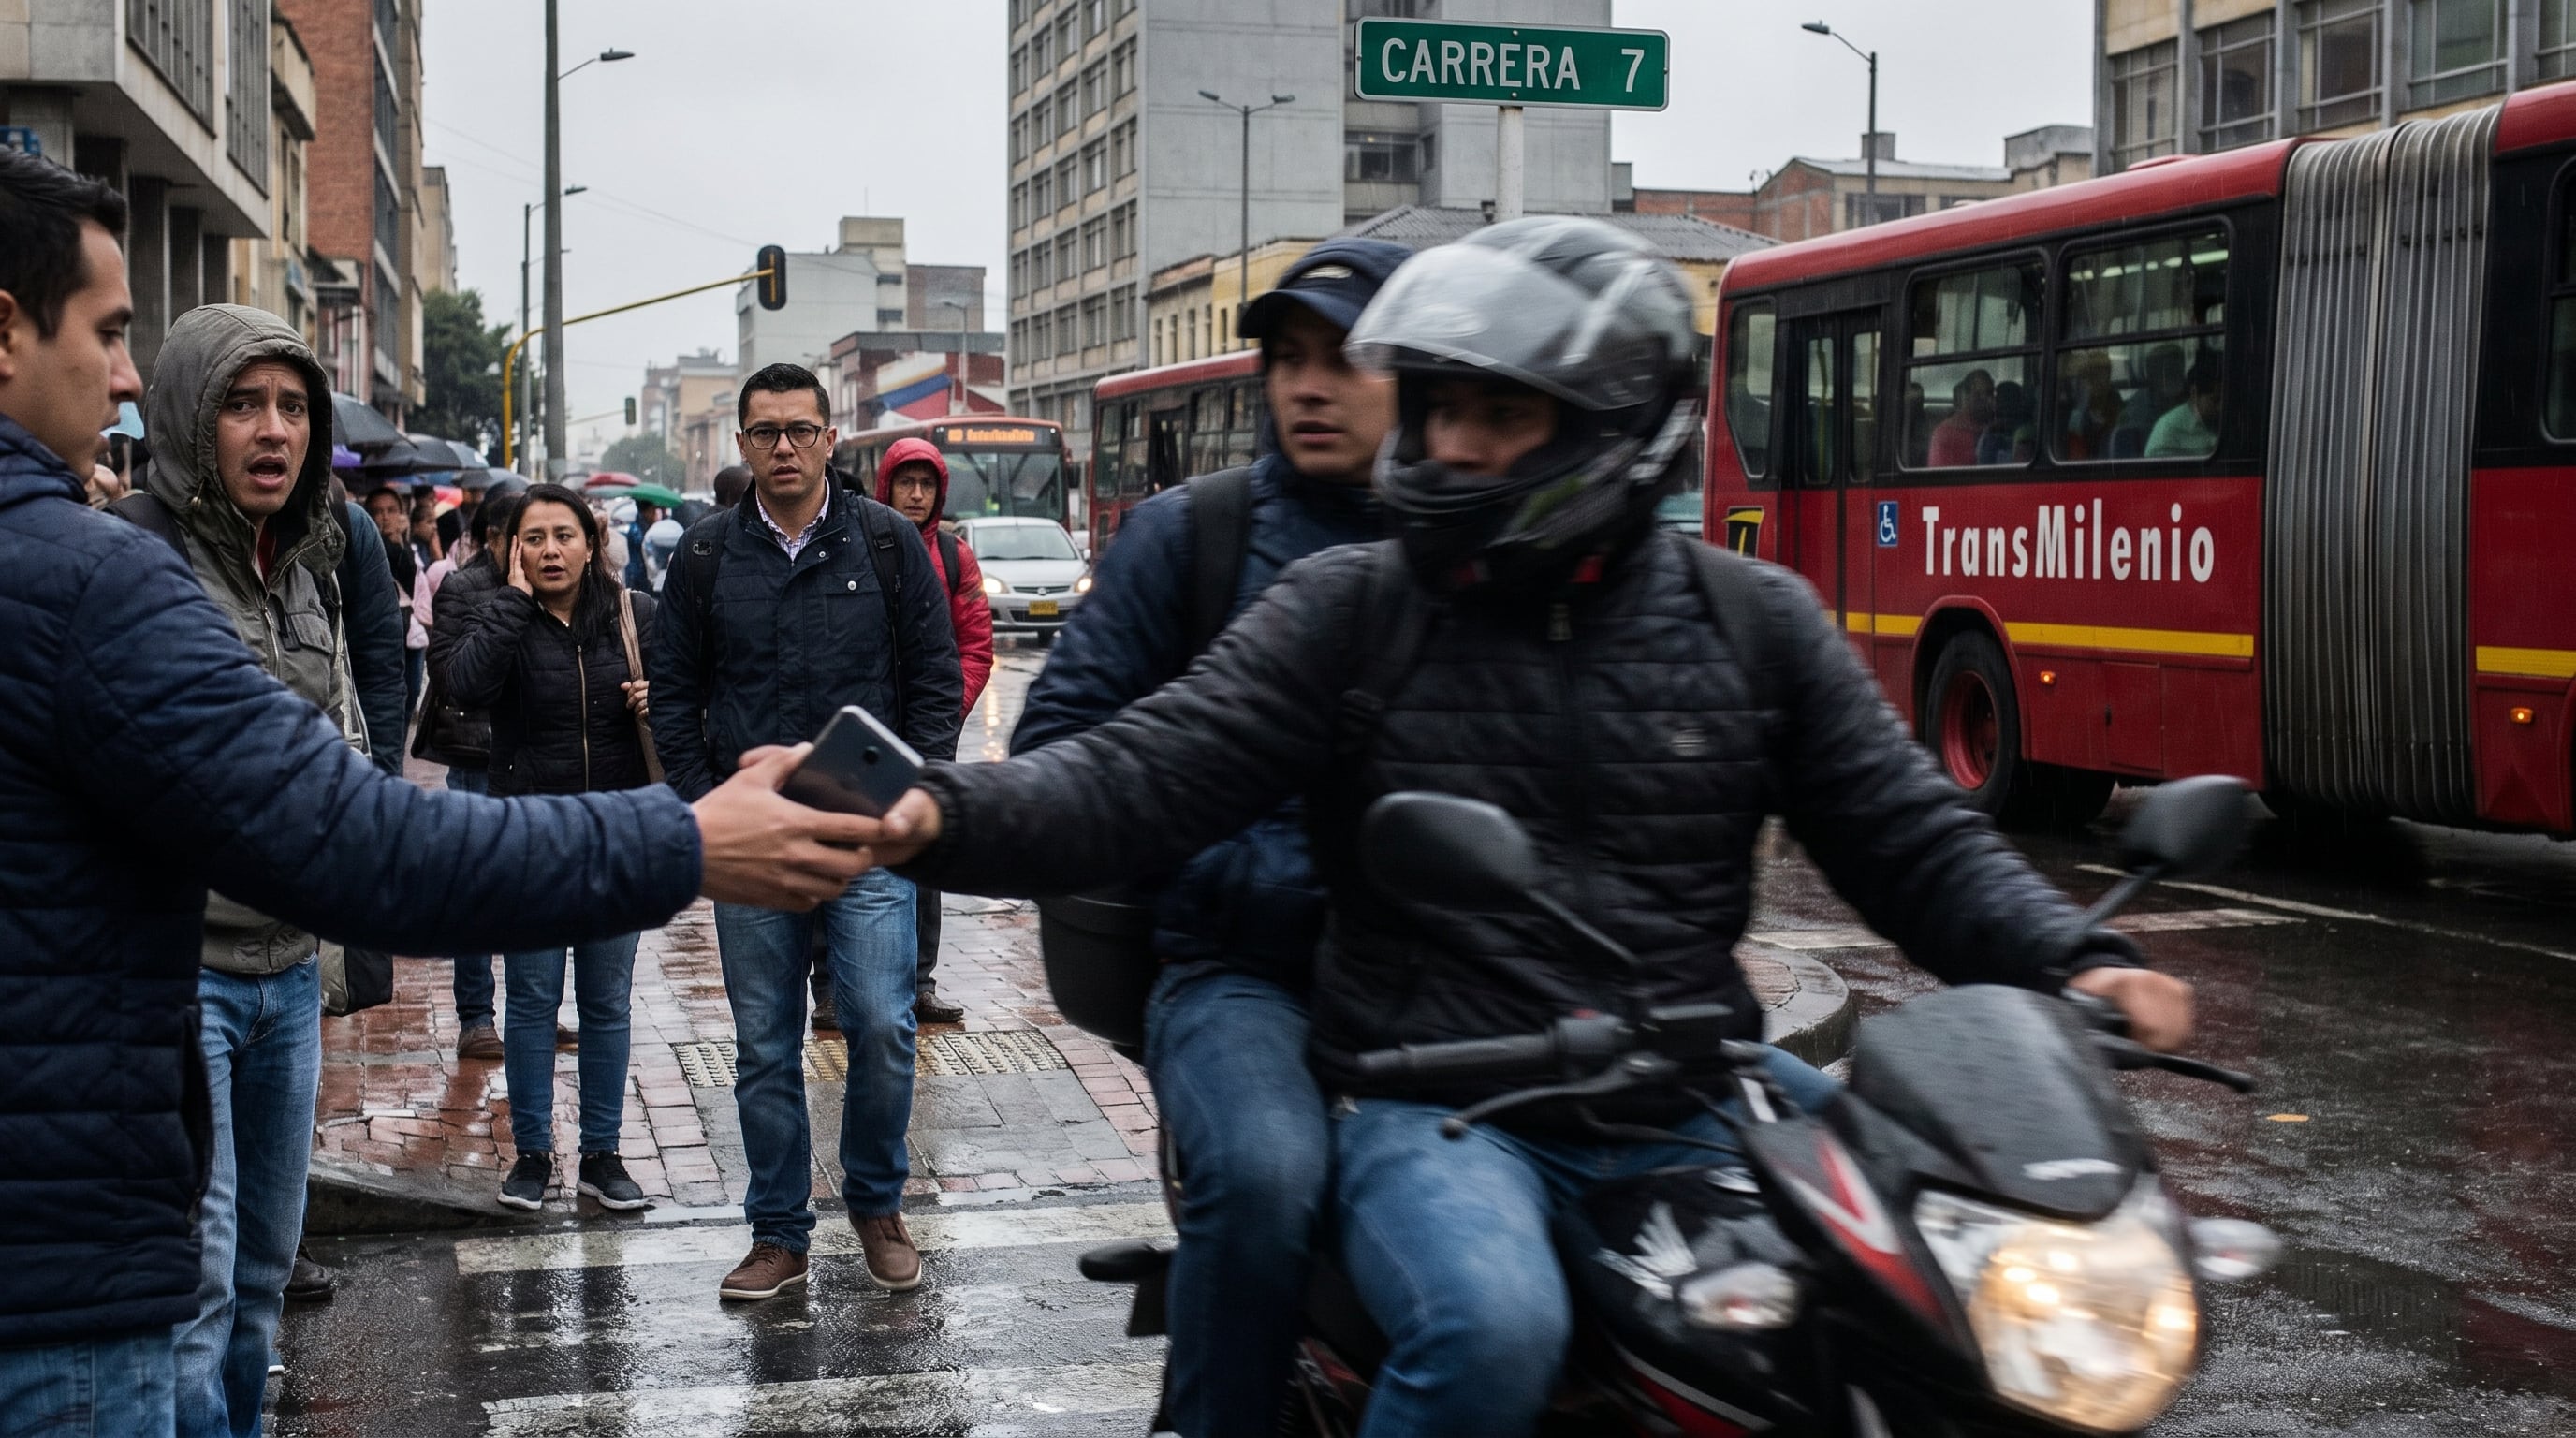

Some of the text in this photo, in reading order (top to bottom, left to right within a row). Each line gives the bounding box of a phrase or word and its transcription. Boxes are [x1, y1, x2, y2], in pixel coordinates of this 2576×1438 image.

[1381, 37, 1645, 93] CARRERA 7
[1922, 498, 2215, 583] TransMilenio
